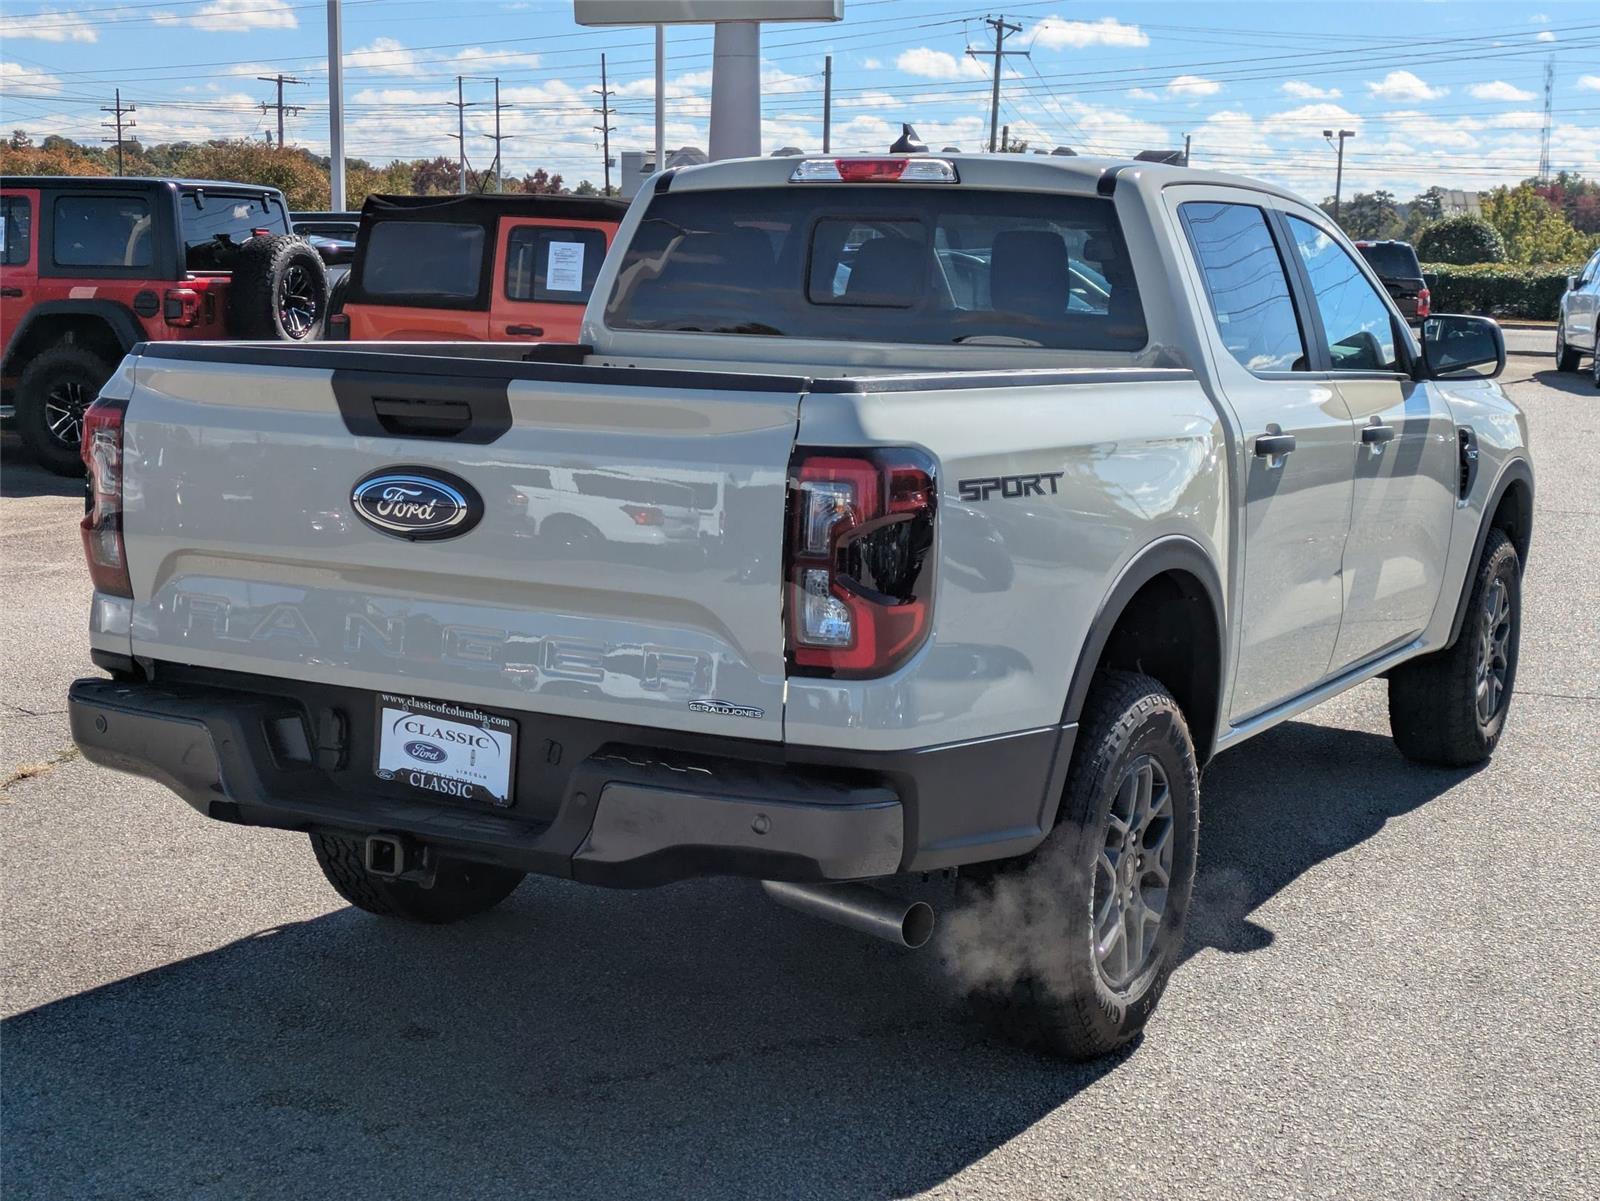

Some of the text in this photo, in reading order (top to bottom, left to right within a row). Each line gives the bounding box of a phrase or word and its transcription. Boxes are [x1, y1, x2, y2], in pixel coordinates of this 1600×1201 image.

[958, 471, 1064, 501] SPORT
[376, 486, 437, 519] Ford
[174, 591, 714, 698] RANGER
[382, 694, 510, 727] www.classicofcolumbia.com
[404, 721, 489, 749] CLASSIC
[411, 743, 439, 761] Ford
[409, 772, 473, 798] CLASSIC
